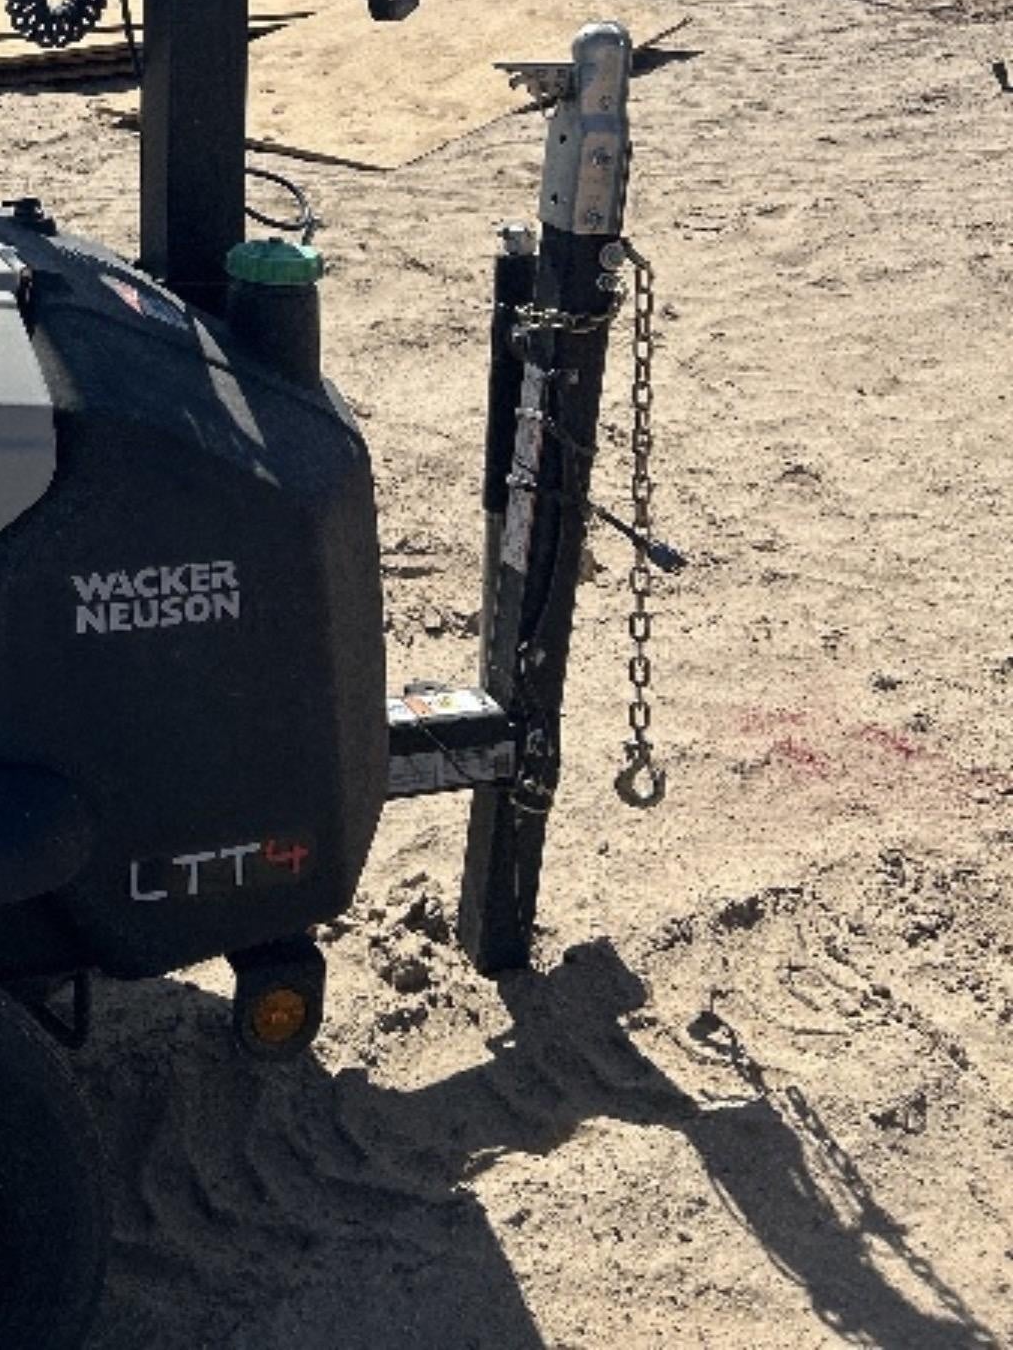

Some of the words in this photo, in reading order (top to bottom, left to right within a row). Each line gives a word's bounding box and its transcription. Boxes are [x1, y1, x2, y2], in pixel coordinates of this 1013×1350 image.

[71, 560, 240, 602] WACKER
[76, 590, 240, 634] NEUSON
[130, 839, 309, 901] LTT4
